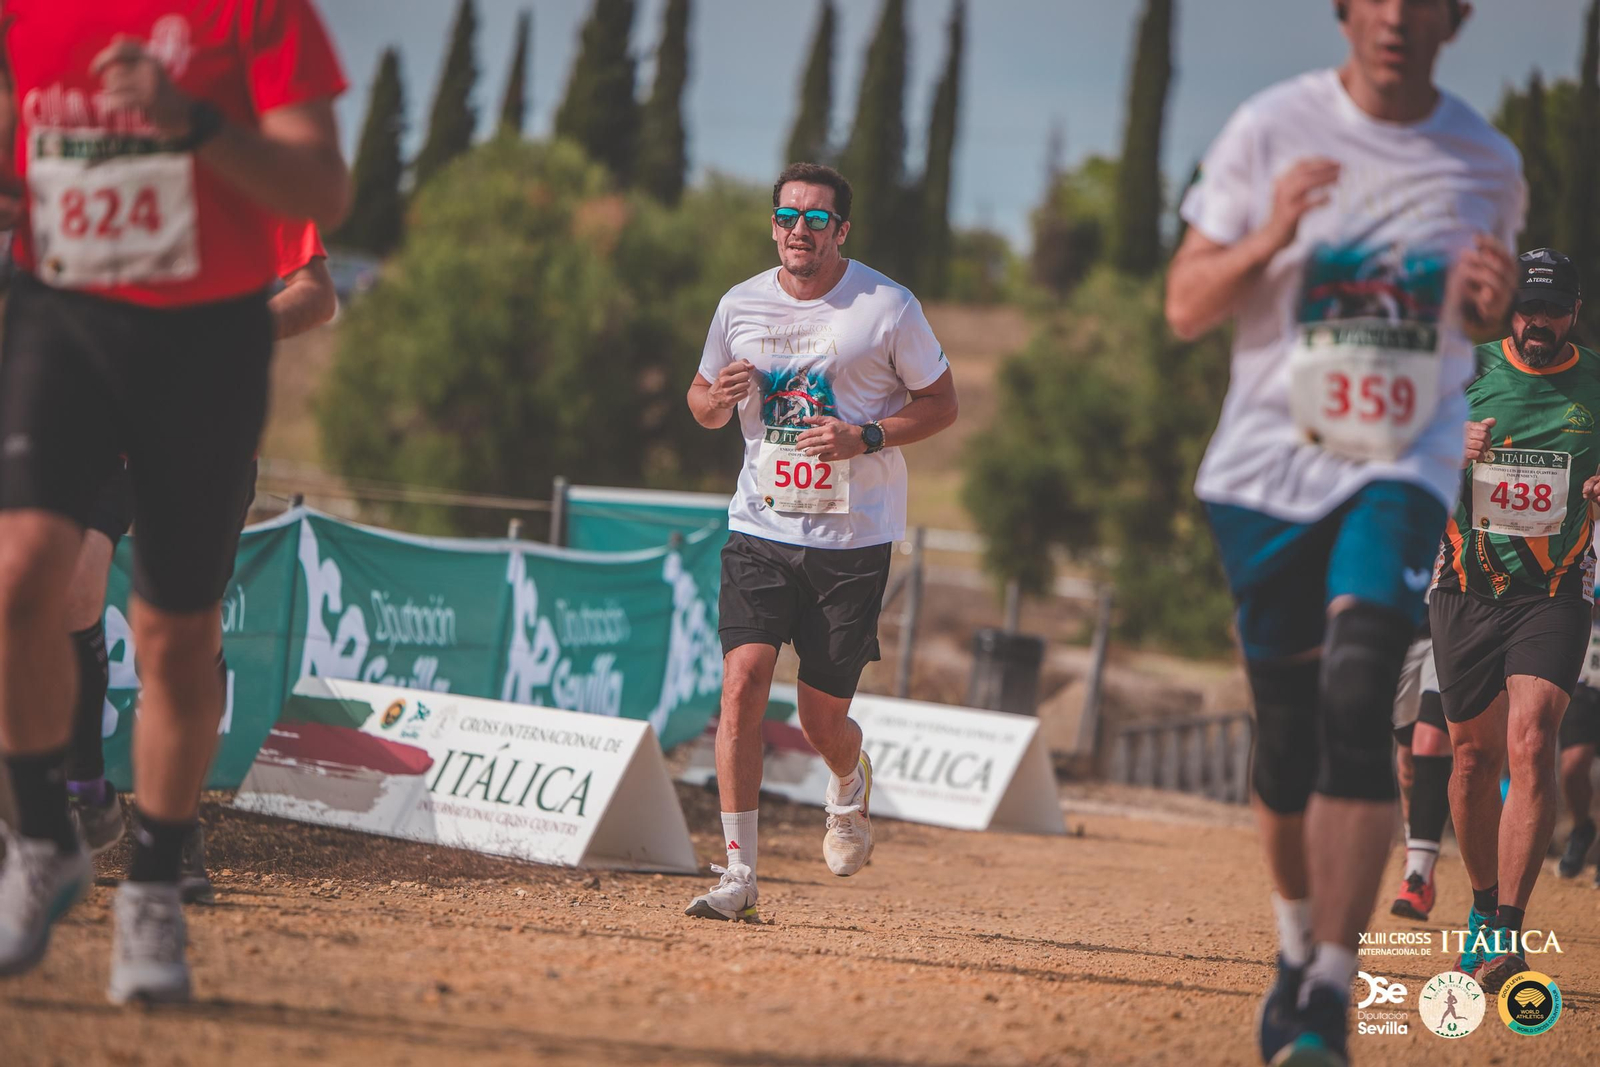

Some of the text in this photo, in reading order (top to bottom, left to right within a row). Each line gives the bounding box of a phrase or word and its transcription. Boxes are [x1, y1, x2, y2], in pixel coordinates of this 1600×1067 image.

[61, 187, 162, 239] 824
[802, 324, 833, 332] CROSS
[1324, 371, 1416, 427] 359
[775, 460, 832, 489] 502
[1501, 452, 1545, 465] ITÁLICA
[1490, 481, 1552, 512] 438
[371, 589, 457, 654] Diputación
[459, 716, 624, 753] CROSS INTERNACIONAL DE
[430, 742, 593, 818] ITÁLICA
[529, 817, 580, 837] COUNTRY
